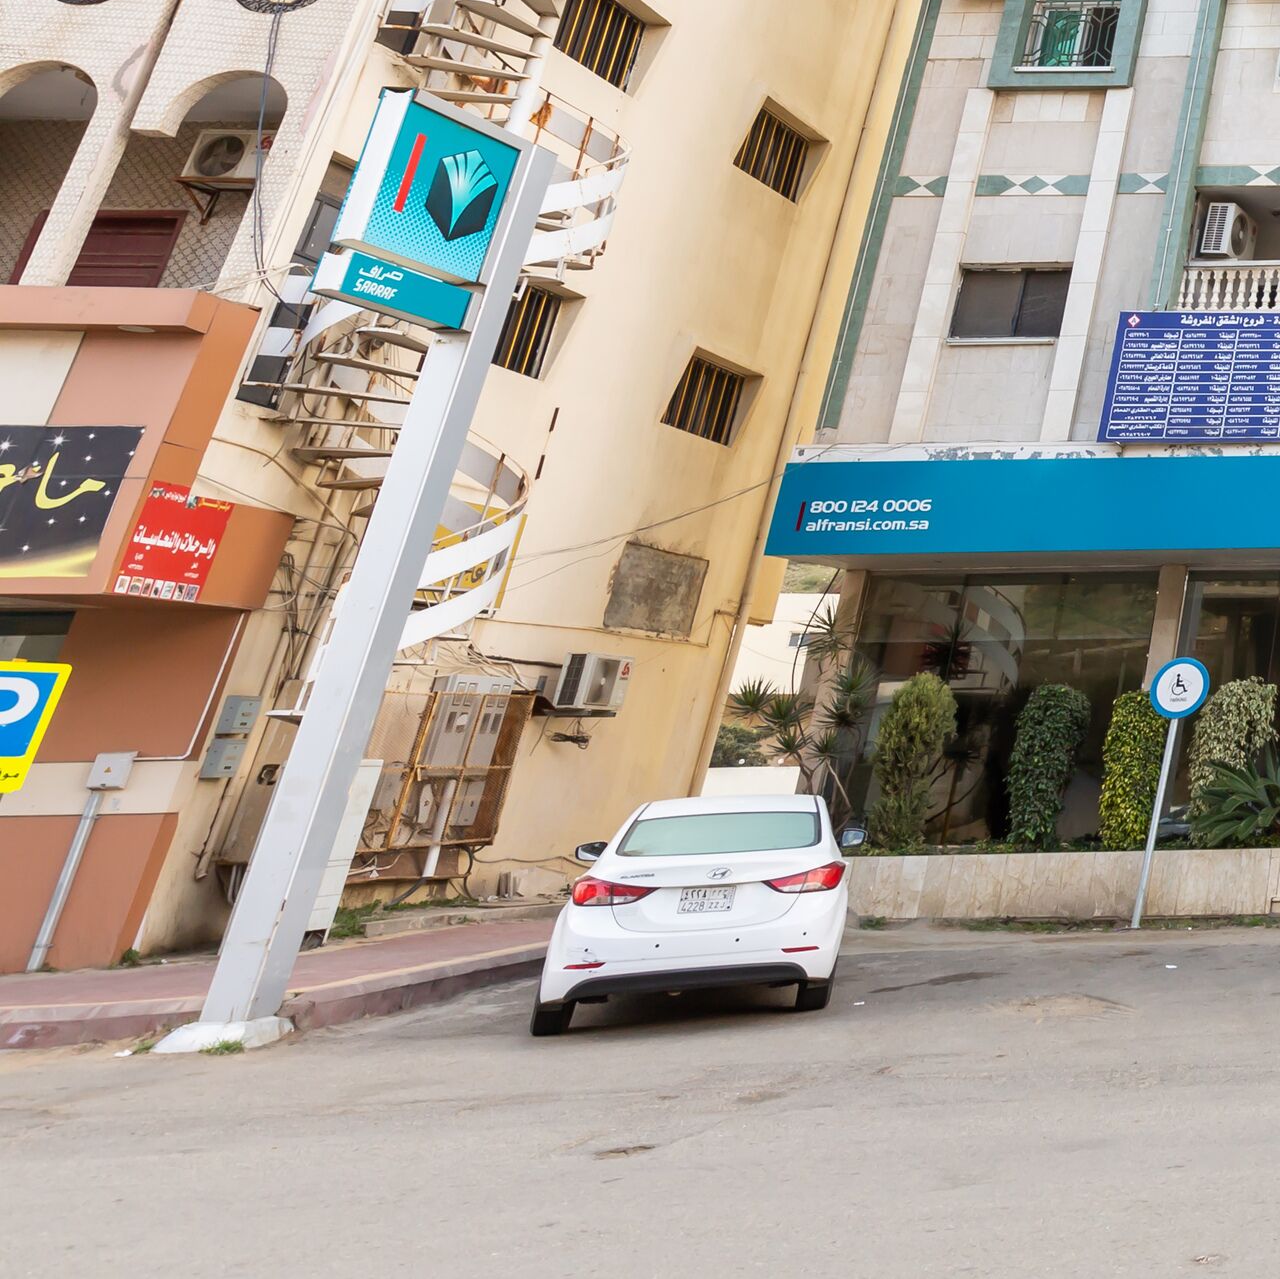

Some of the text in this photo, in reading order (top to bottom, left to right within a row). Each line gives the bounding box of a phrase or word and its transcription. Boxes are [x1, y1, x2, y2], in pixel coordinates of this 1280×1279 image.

[358, 264, 404, 281] صراف
[352, 278, 398, 300] SARRAF
[810, 499, 932, 514] 800 124 0006
[805, 518, 930, 532] alfransi.com.sa
[681, 901, 705, 912] 4228
